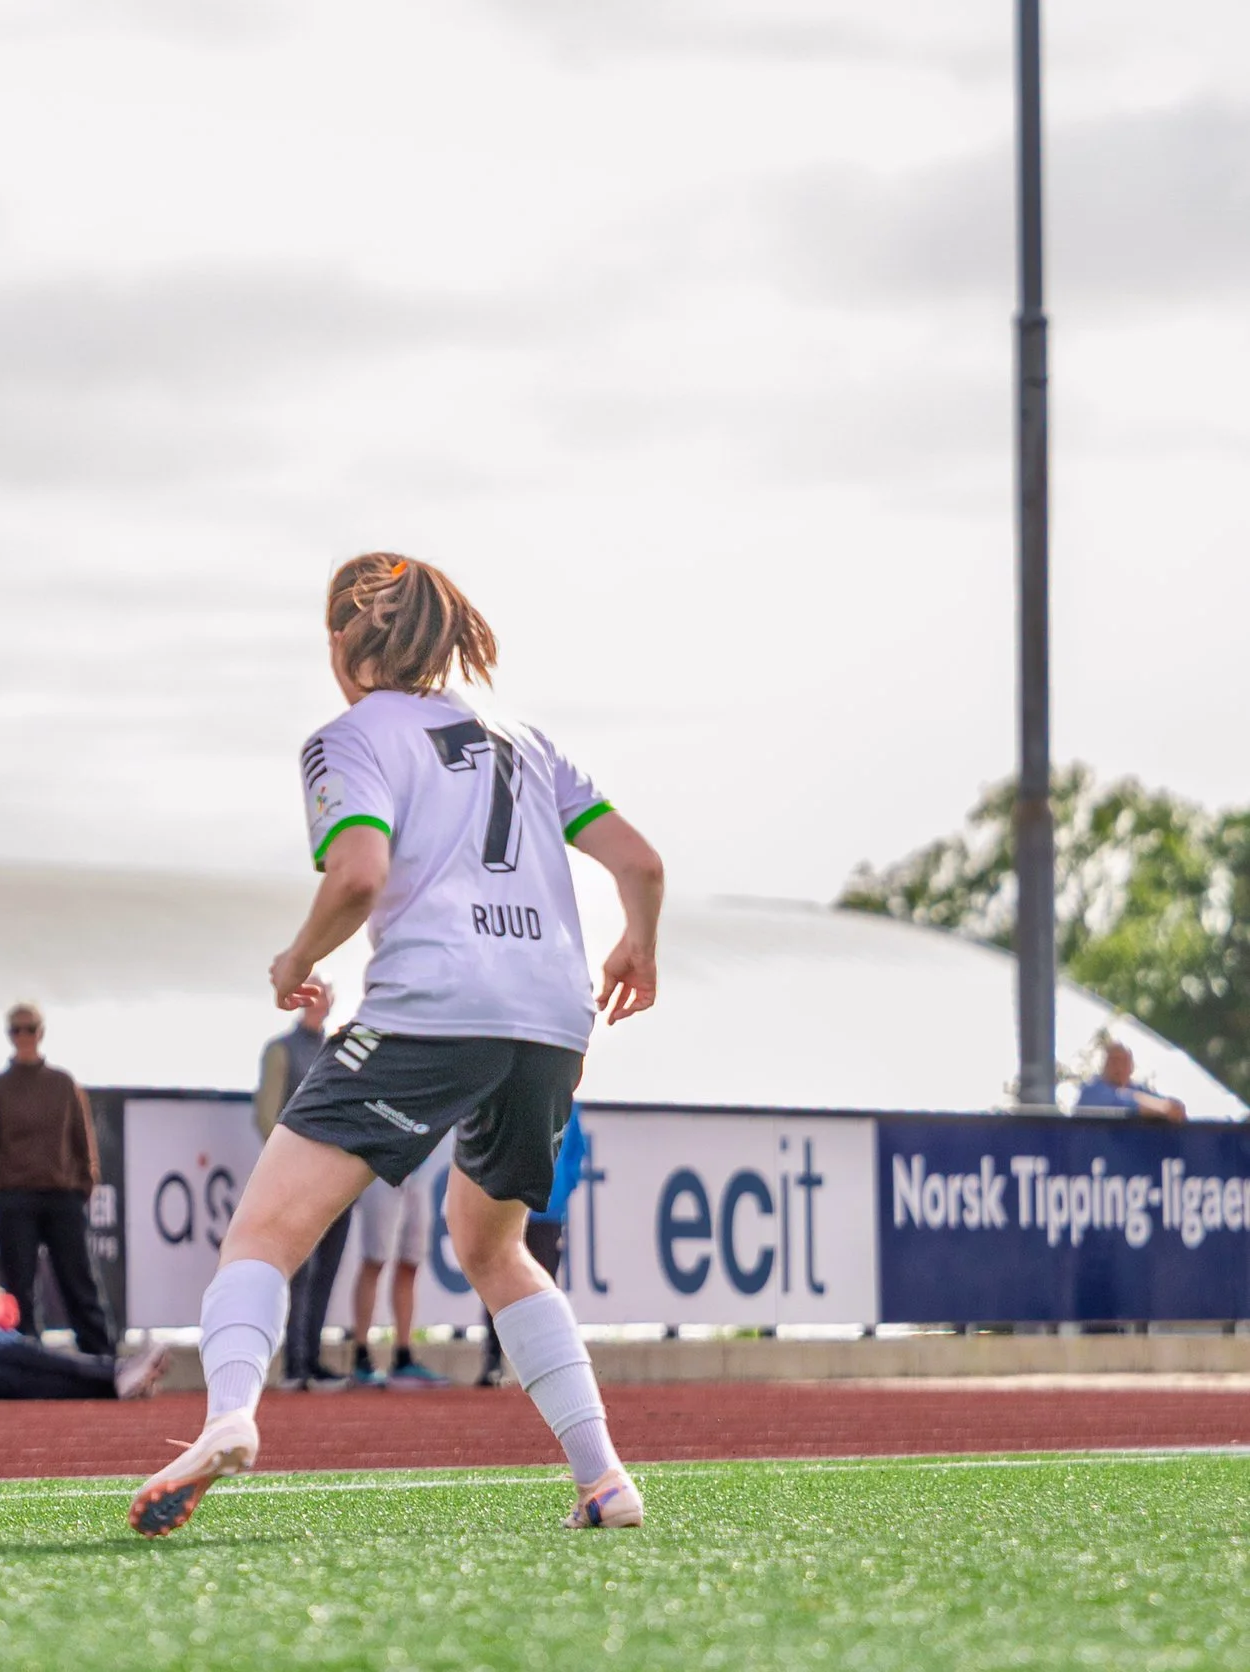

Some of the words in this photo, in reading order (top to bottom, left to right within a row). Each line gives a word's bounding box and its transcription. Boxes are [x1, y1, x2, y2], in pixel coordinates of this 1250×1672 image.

[424, 717, 523, 873] 7
[471, 902, 541, 940] RUUD
[656, 1135, 825, 1296] ecit
[892, 1153, 1008, 1229] Norsk
[1010, 1156, 1250, 1249] Tipping-ligae
